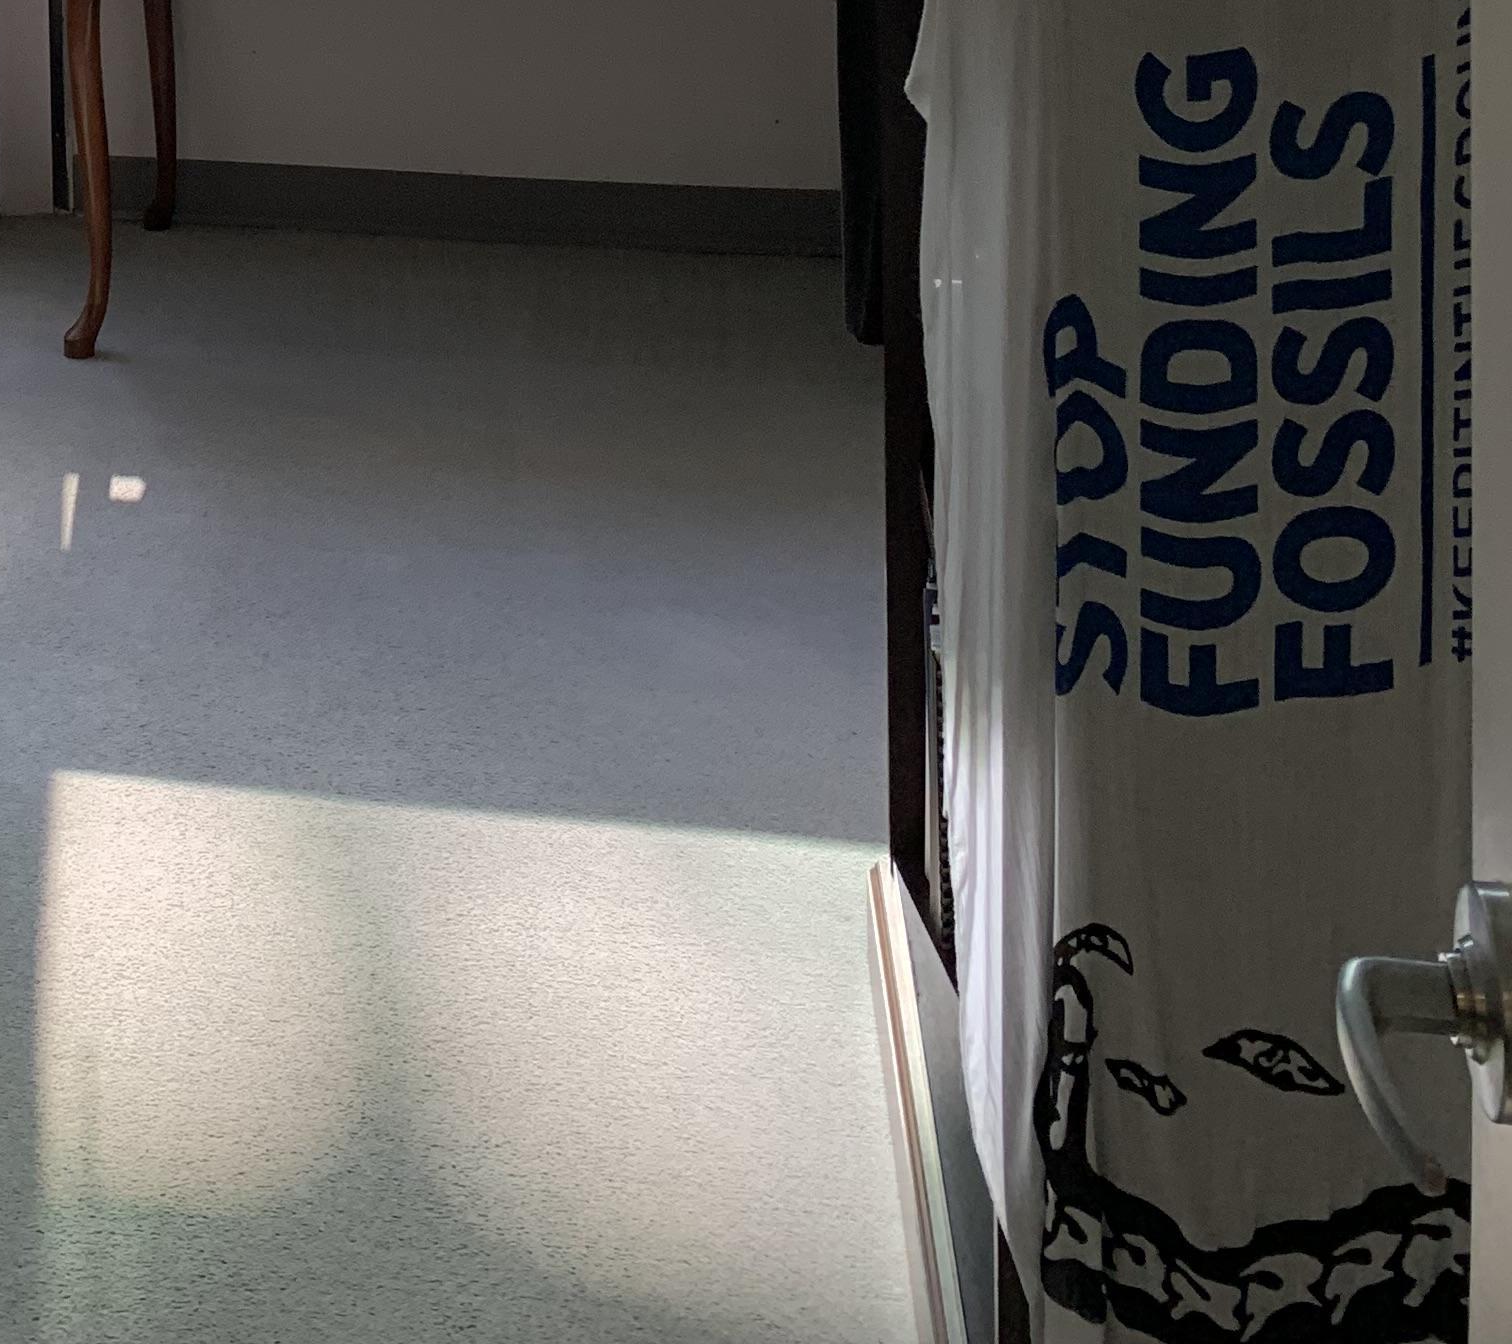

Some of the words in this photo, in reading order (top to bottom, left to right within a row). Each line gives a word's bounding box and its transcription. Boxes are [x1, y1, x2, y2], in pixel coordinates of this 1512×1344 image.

[1044, 293, 1129, 697] STOP
[1134, 46, 1262, 717] FUNDING
[1269, 90, 1396, 702] FOSSILS
